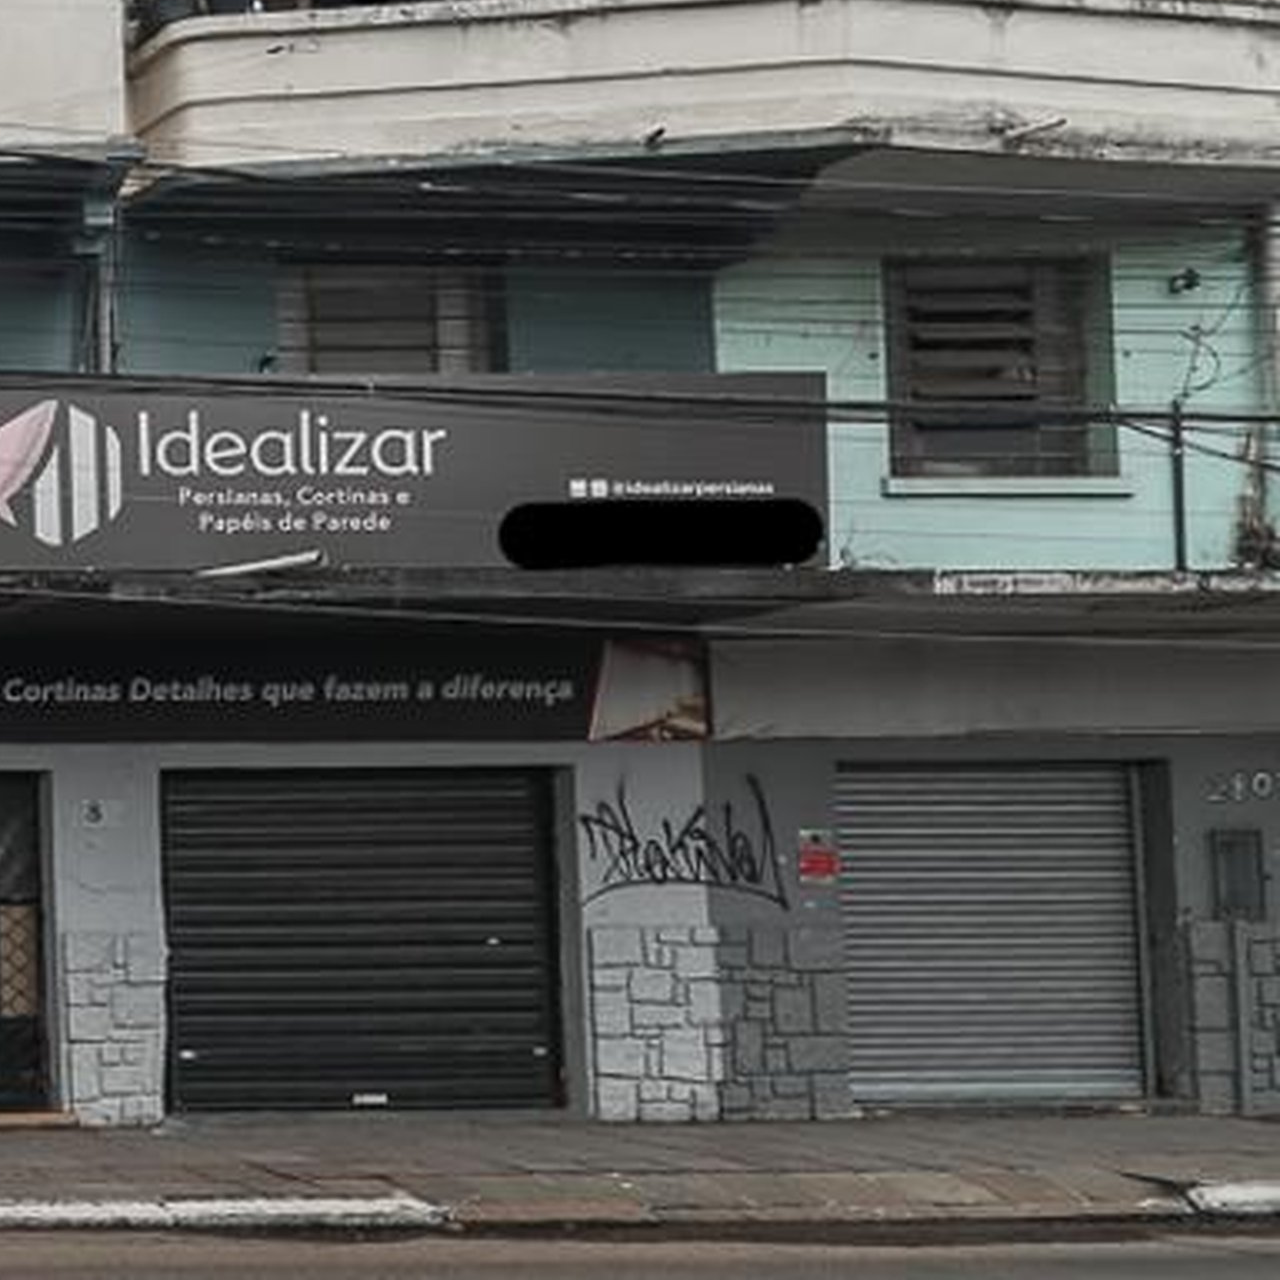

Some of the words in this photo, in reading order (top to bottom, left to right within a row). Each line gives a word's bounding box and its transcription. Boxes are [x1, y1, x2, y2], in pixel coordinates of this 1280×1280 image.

[138, 410, 447, 475] Idealizar
[178, 487, 291, 507] Persianas,
[296, 486, 389, 506] Cortinas
[396, 492, 410, 505] e
[198, 512, 272, 534] Papéis
[279, 513, 307, 532] de
[312, 512, 392, 532] Parede
[3, 677, 121, 702] Cortinas
[130, 677, 254, 702] Detalhes
[261, 684, 313, 706] que
[323, 675, 409, 701] fazem
[416, 684, 434, 699] a
[443, 674, 573, 705] diferença
